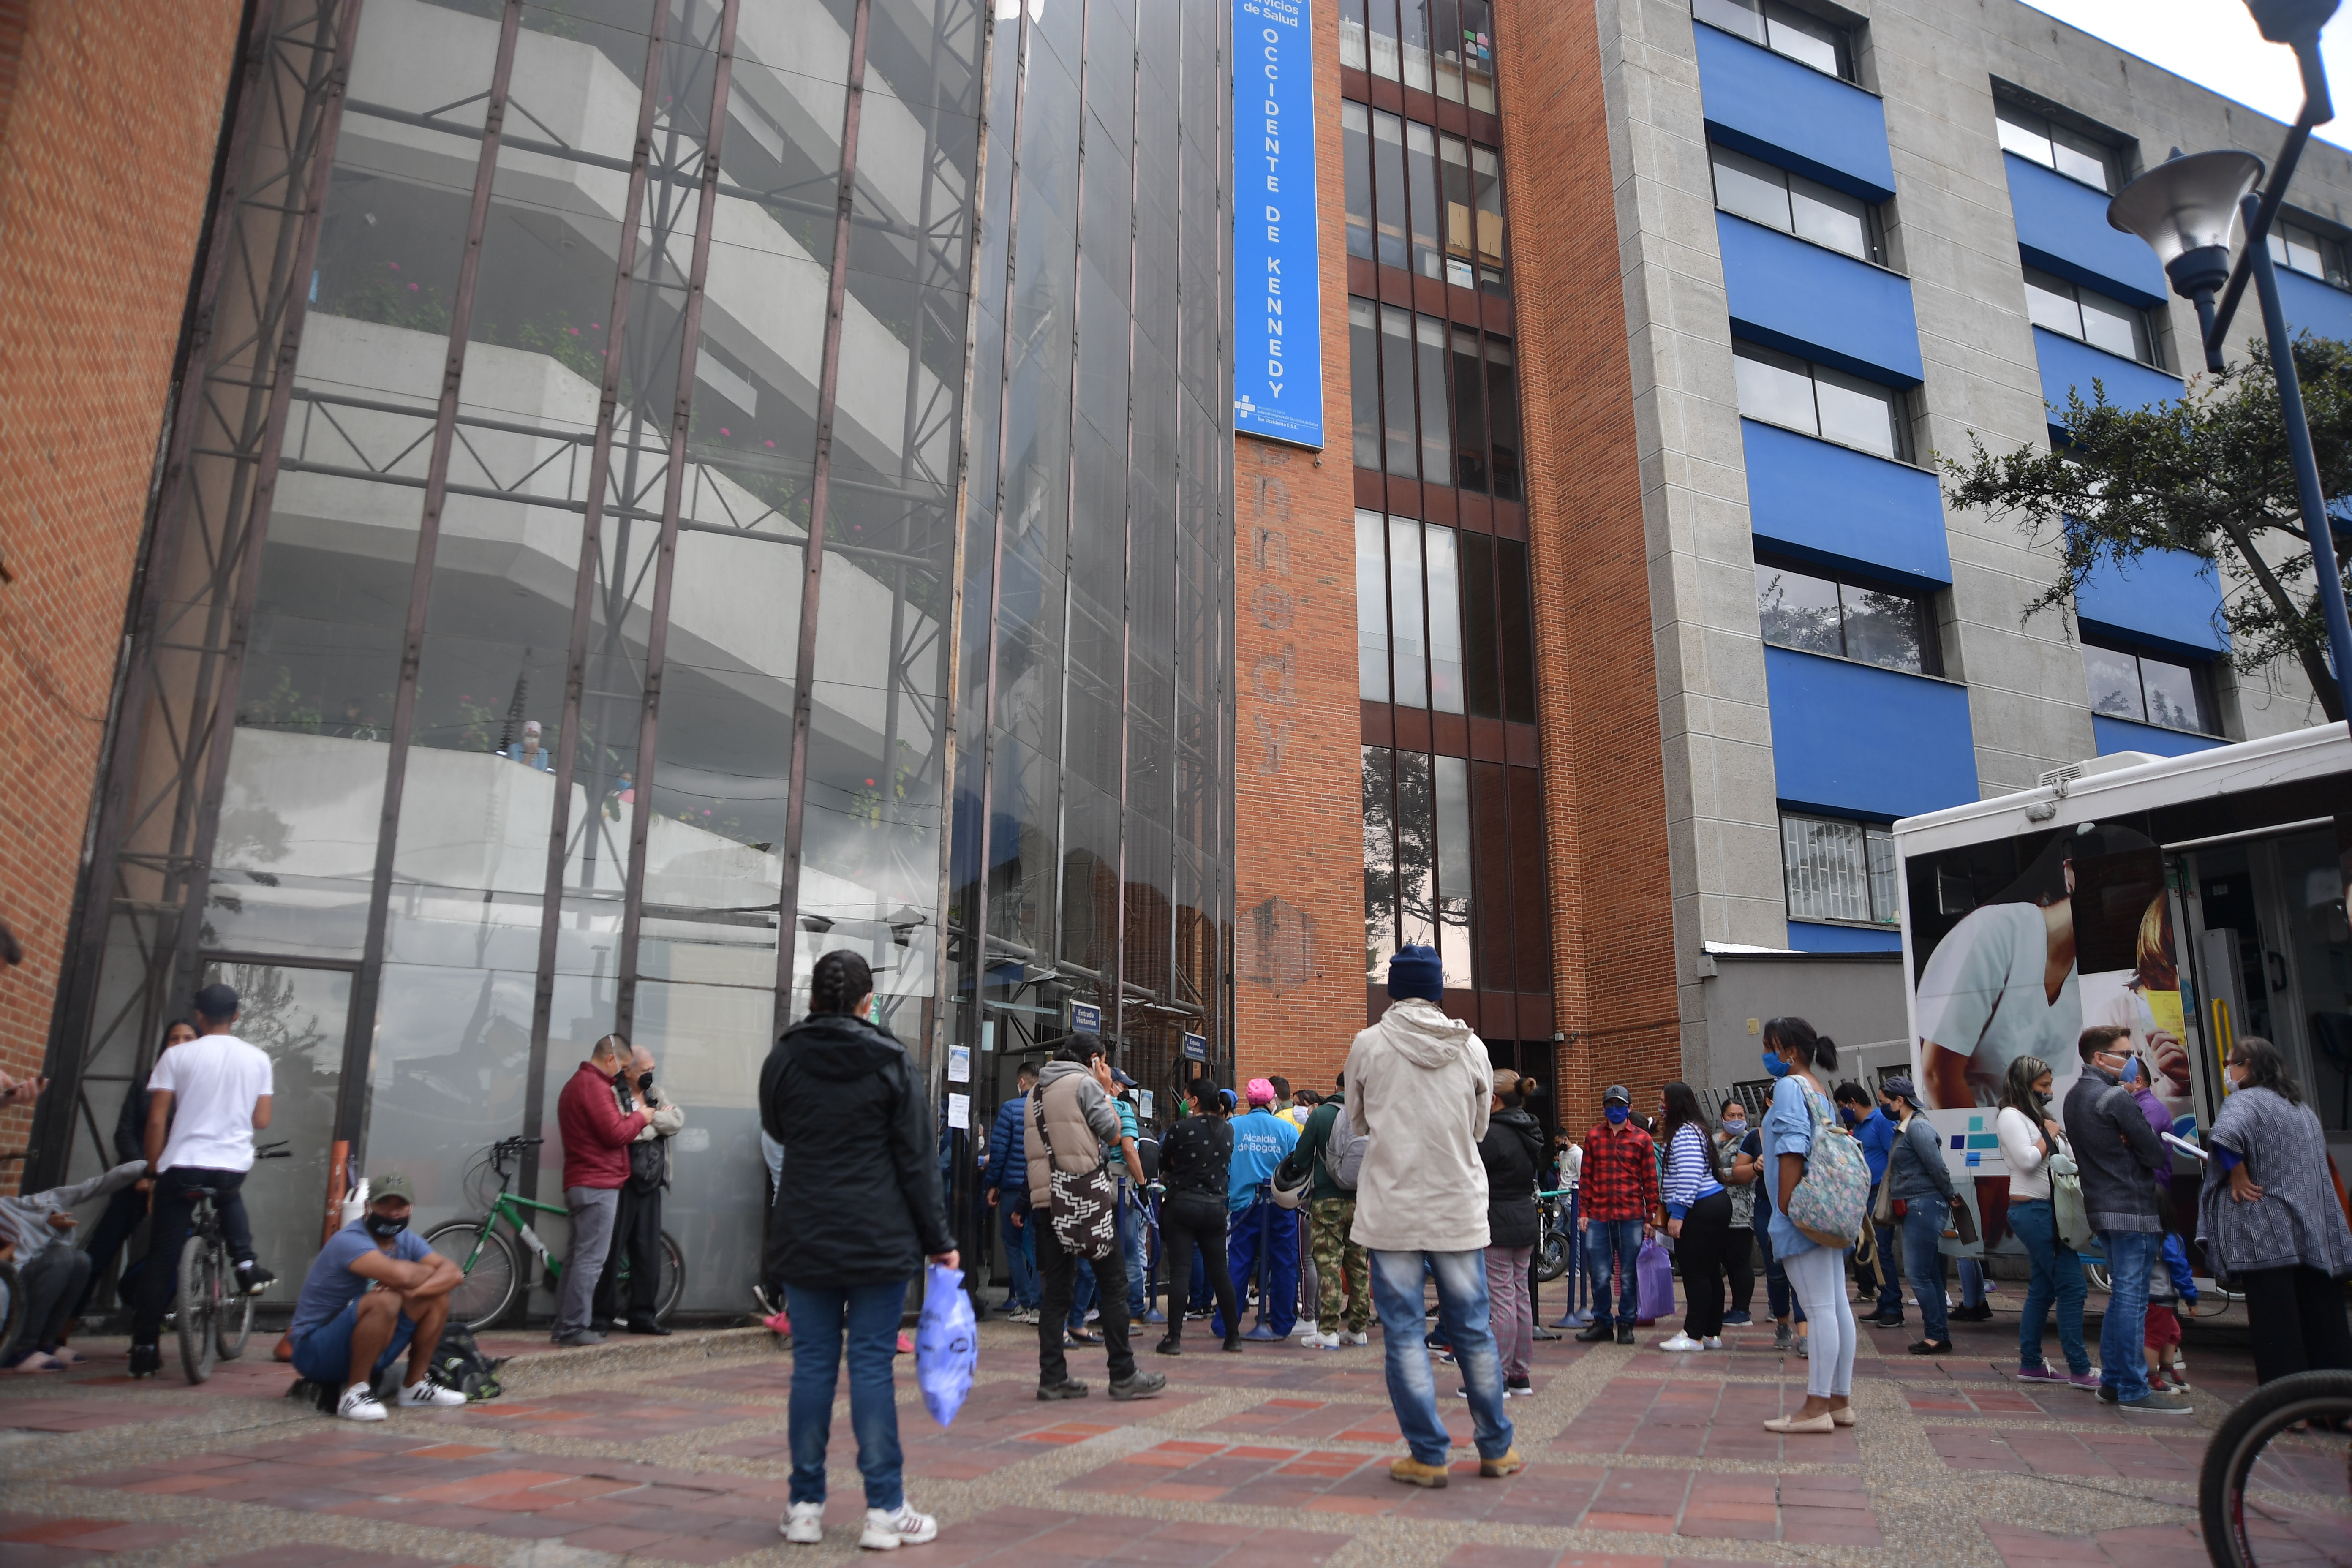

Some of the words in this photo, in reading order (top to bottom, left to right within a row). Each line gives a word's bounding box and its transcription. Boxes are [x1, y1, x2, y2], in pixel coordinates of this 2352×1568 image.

[1252, 0, 1298, 15] vicios
[1244, 2, 1260, 14] de
[1263, 8, 1298, 27] Salud
[1263, 28, 1279, 193] OCCIDENTE
[1266, 205, 1280, 242] DE
[1268, 256, 1284, 398] KENNEDY
[1265, 418, 1286, 427] Occidente
[1078, 1009, 1094, 1018] Entrada
[1076, 1016, 1097, 1026] Visitantes
[1190, 1038, 1200, 1047] Entrada
[1186, 1044, 1203, 1054] Funcionarios
[1242, 1133, 1276, 1143] Alcaldía
[1238, 1142, 1248, 1152] de
[1250, 1142, 1281, 1153] Bogotá
